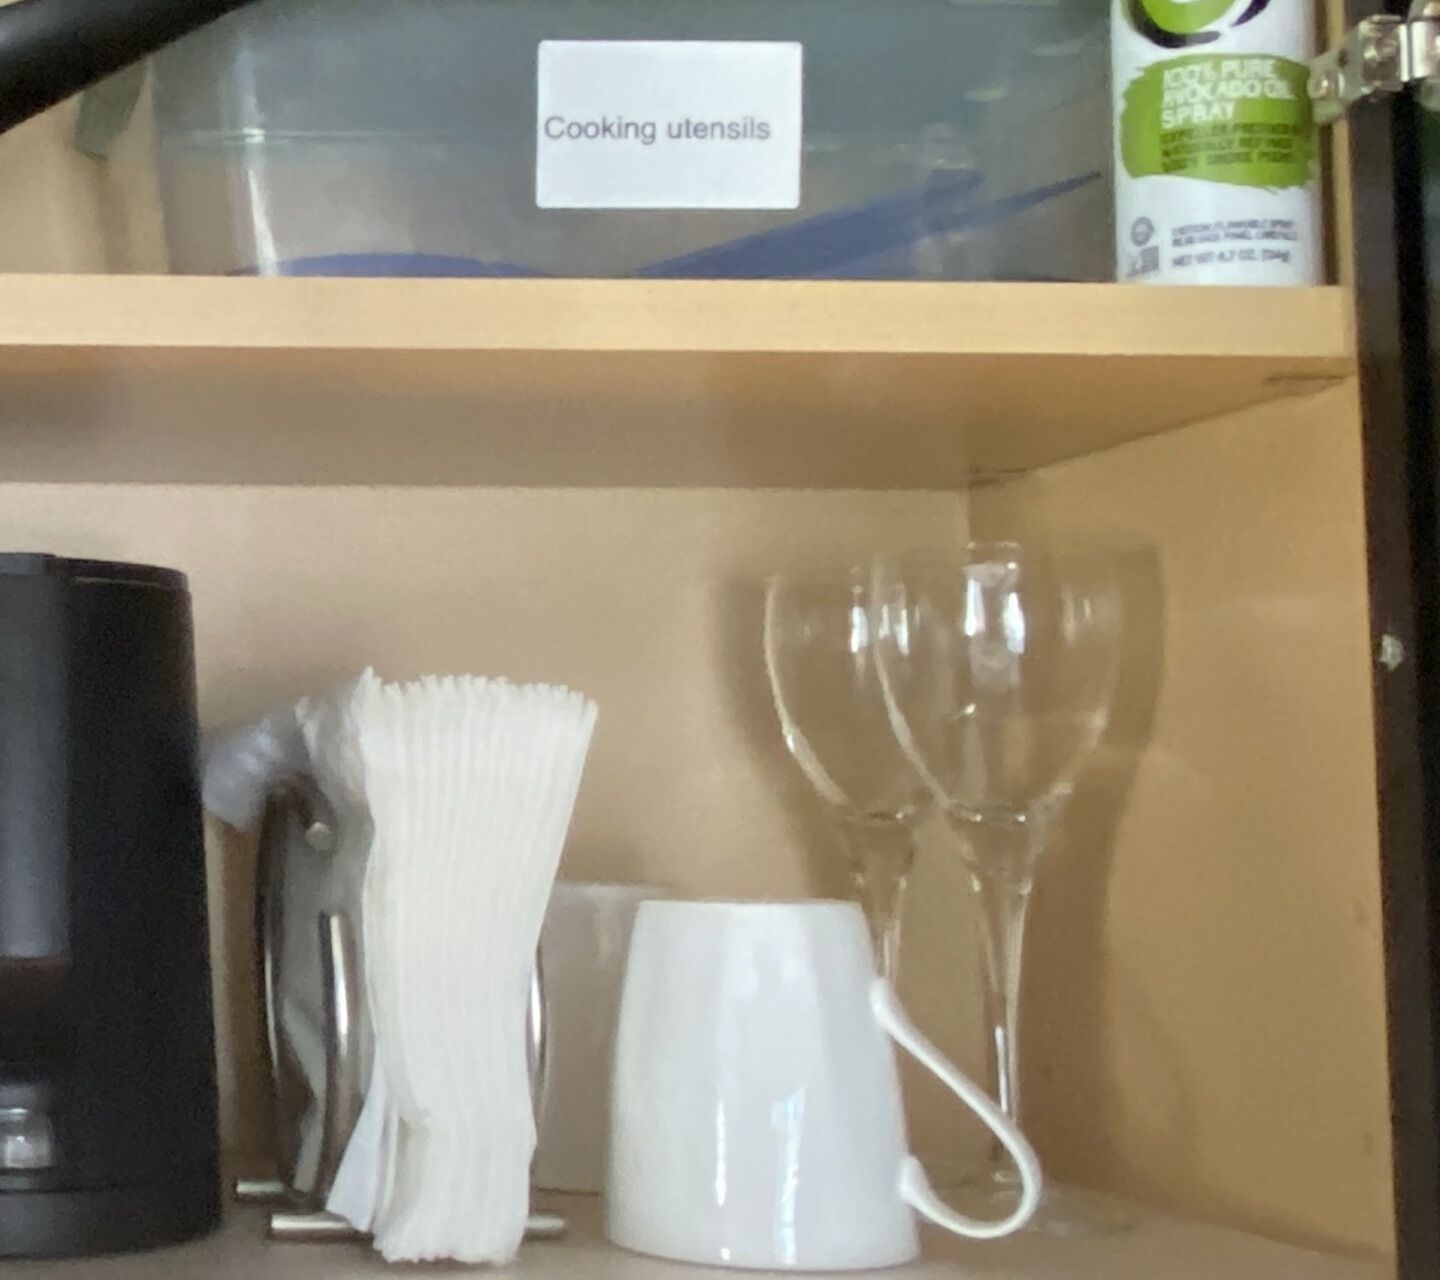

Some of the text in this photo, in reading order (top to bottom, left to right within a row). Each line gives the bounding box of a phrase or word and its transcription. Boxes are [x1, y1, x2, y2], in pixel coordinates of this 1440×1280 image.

[1160, 101, 1236, 128] SPRAY
[544, 116, 771, 145] Cooking utensils
